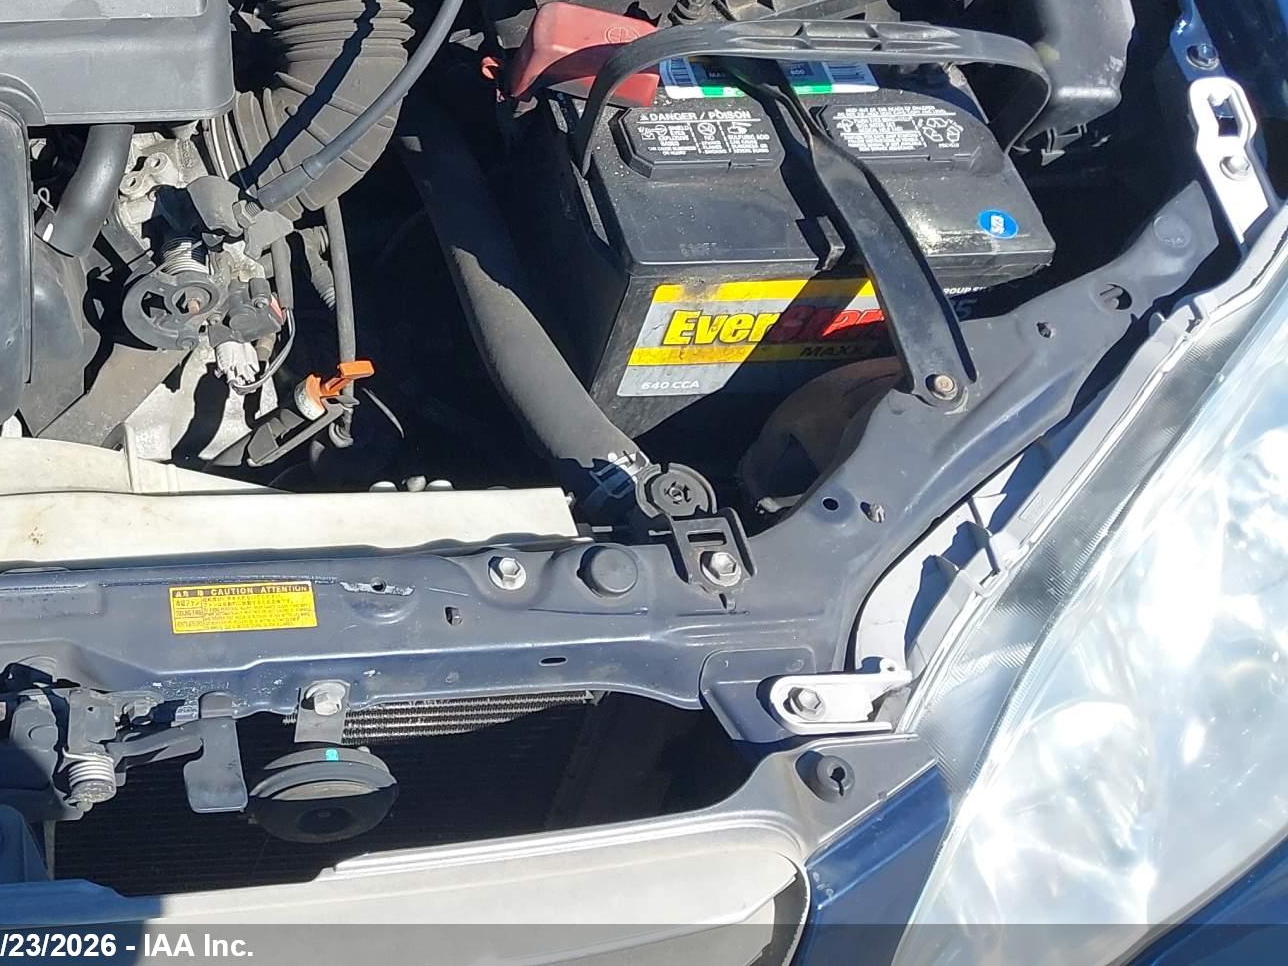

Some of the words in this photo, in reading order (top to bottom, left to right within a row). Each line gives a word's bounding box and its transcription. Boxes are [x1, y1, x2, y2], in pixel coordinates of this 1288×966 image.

[649, 112, 698, 122] DANGER
[708, 110, 752, 120] POISON
[661, 304, 892, 346] EverStar
[641, 380, 674, 390] 640
[673, 380, 701, 390] CCA
[210, 587, 253, 596] CAUTION
[260, 585, 308, 594] ATTENTION
